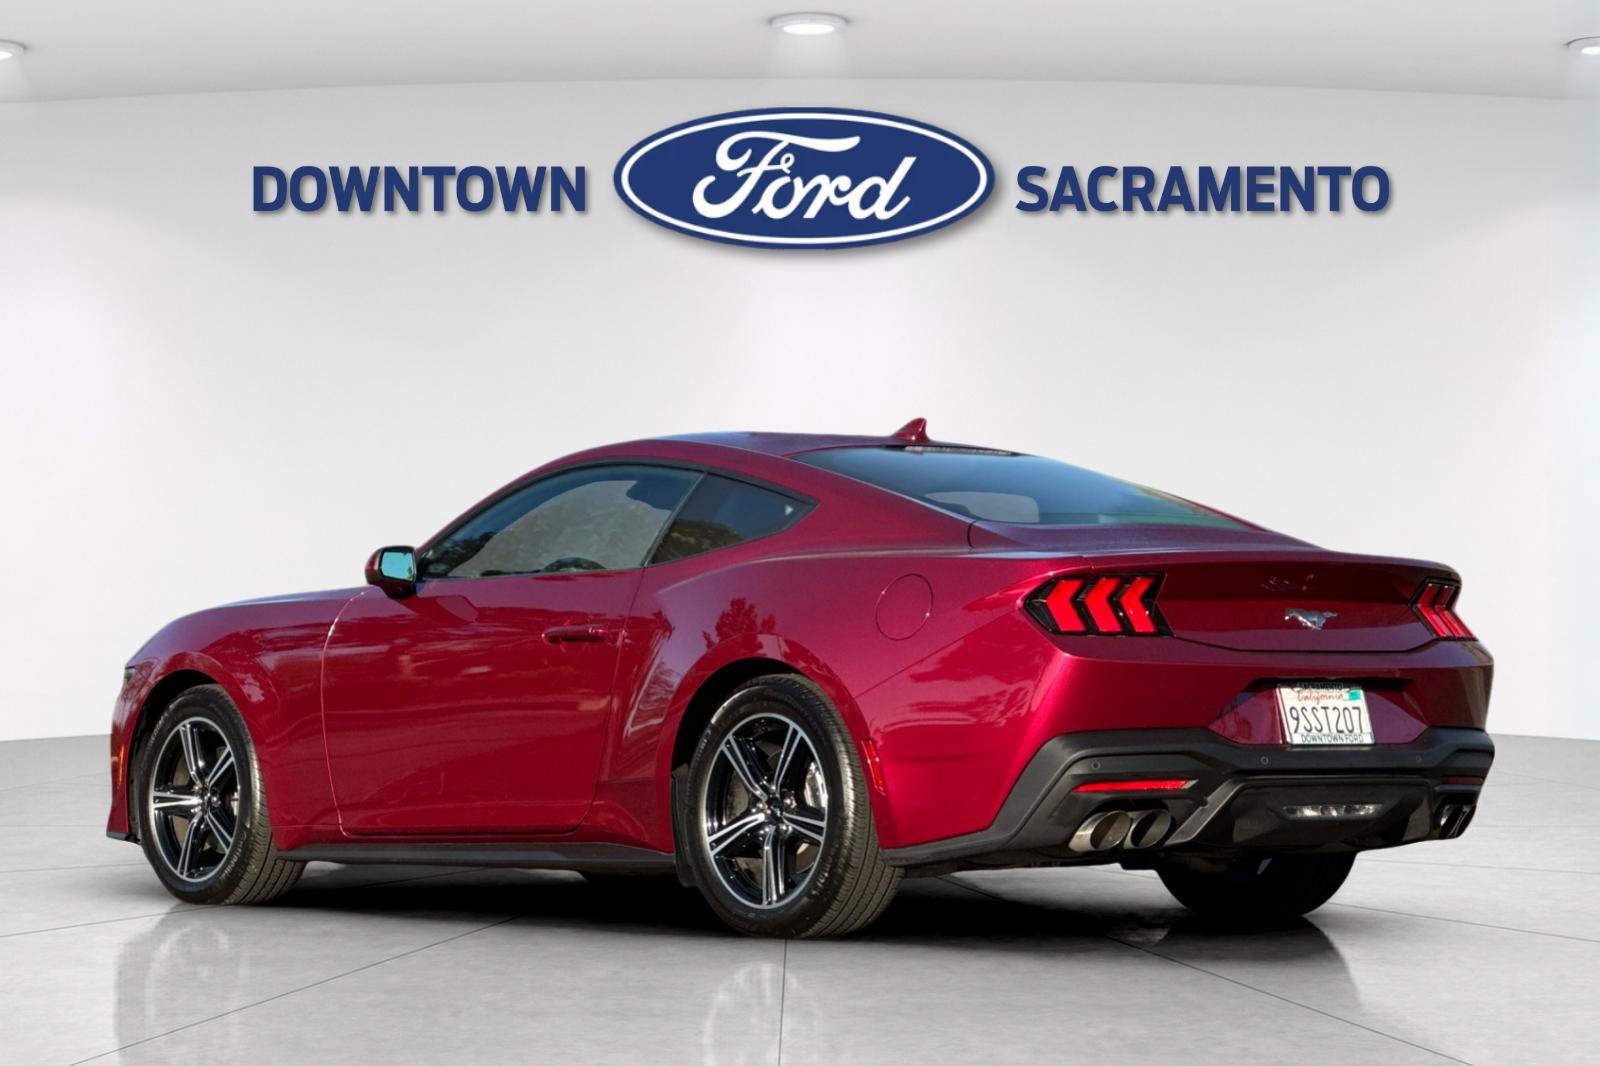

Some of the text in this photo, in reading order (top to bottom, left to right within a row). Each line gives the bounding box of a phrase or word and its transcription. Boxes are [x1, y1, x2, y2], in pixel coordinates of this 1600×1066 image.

[252, 131, 1391, 220] DOWNTOWN Ford SACRAMENTO
[1290, 706, 1363, 733] 9SST207
[1301, 733, 1364, 743] DOWNTOWN FORD
